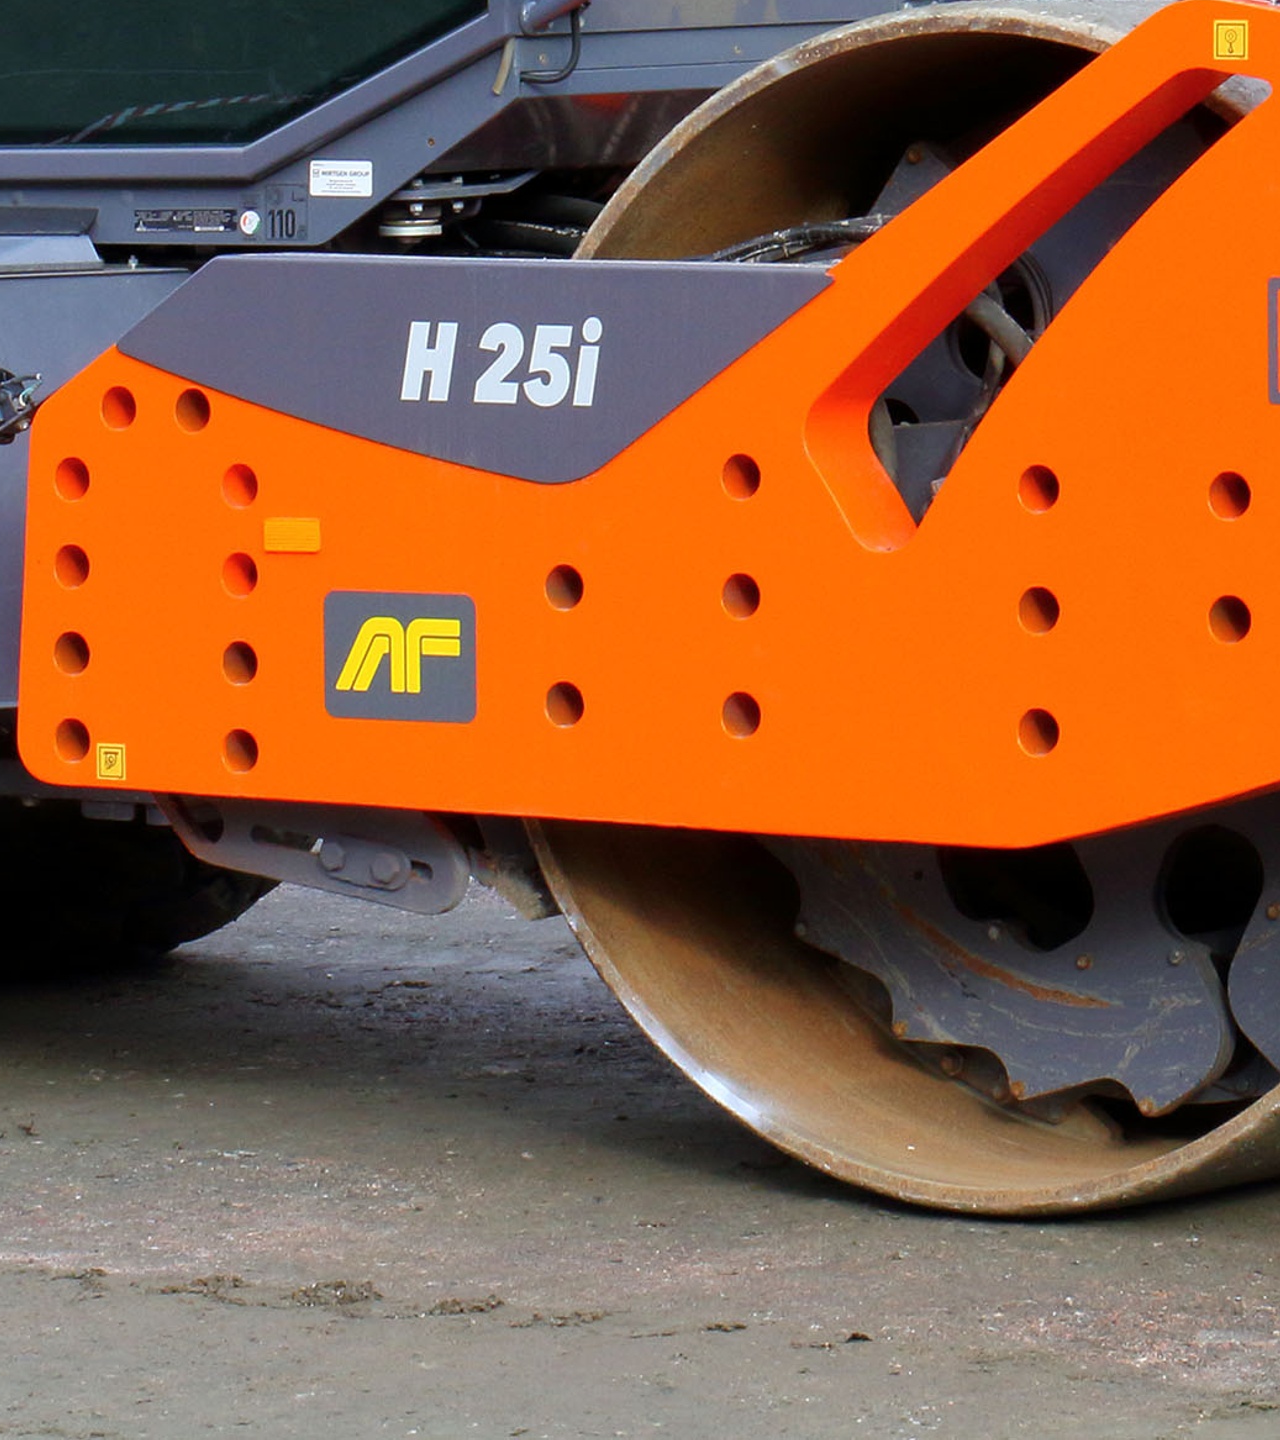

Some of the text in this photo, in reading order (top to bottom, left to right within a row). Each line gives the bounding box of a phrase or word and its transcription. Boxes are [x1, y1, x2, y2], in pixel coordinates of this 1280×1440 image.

[269, 210, 296, 238] 110
[400, 316, 603, 408] H 25i
[335, 616, 461, 693] AF
